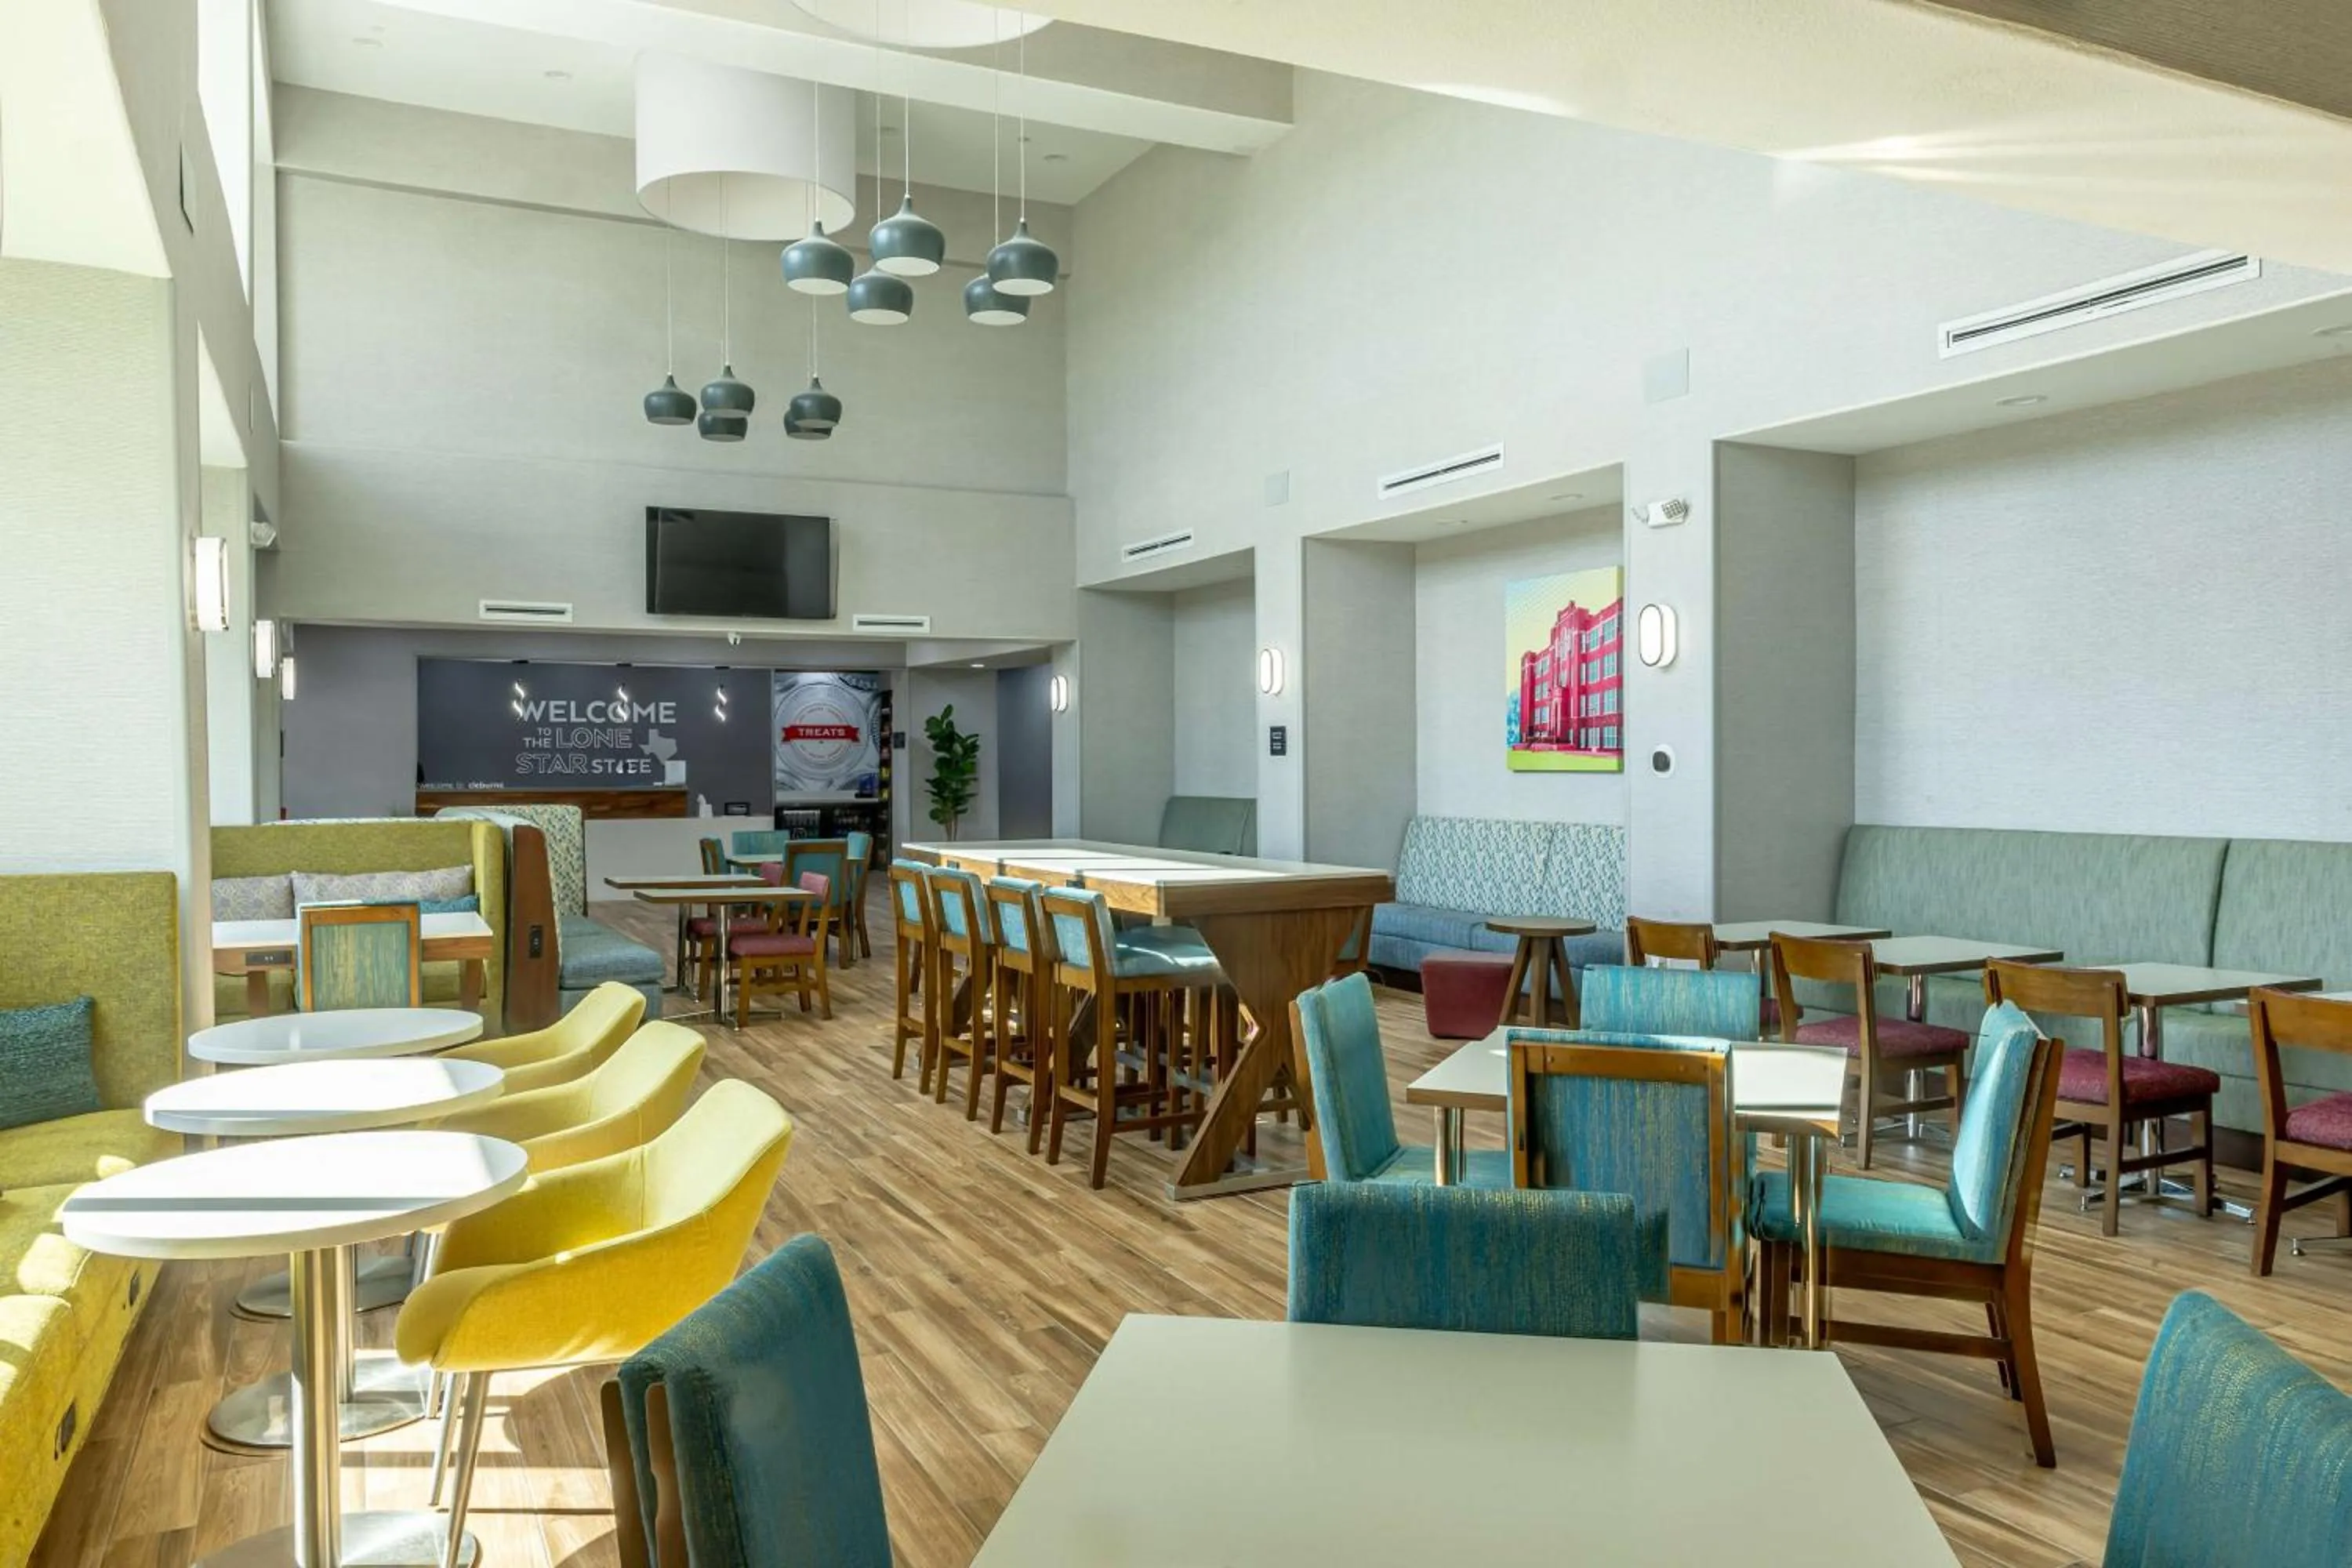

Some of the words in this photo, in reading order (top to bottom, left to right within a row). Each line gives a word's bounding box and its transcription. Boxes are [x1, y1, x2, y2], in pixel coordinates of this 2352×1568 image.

[521, 700, 677, 723] WELCOME
[524, 737, 552, 748] THE
[556, 727, 633, 749] LONE
[798, 728, 845, 737] TREATS
[515, 753, 587, 774] STAR
